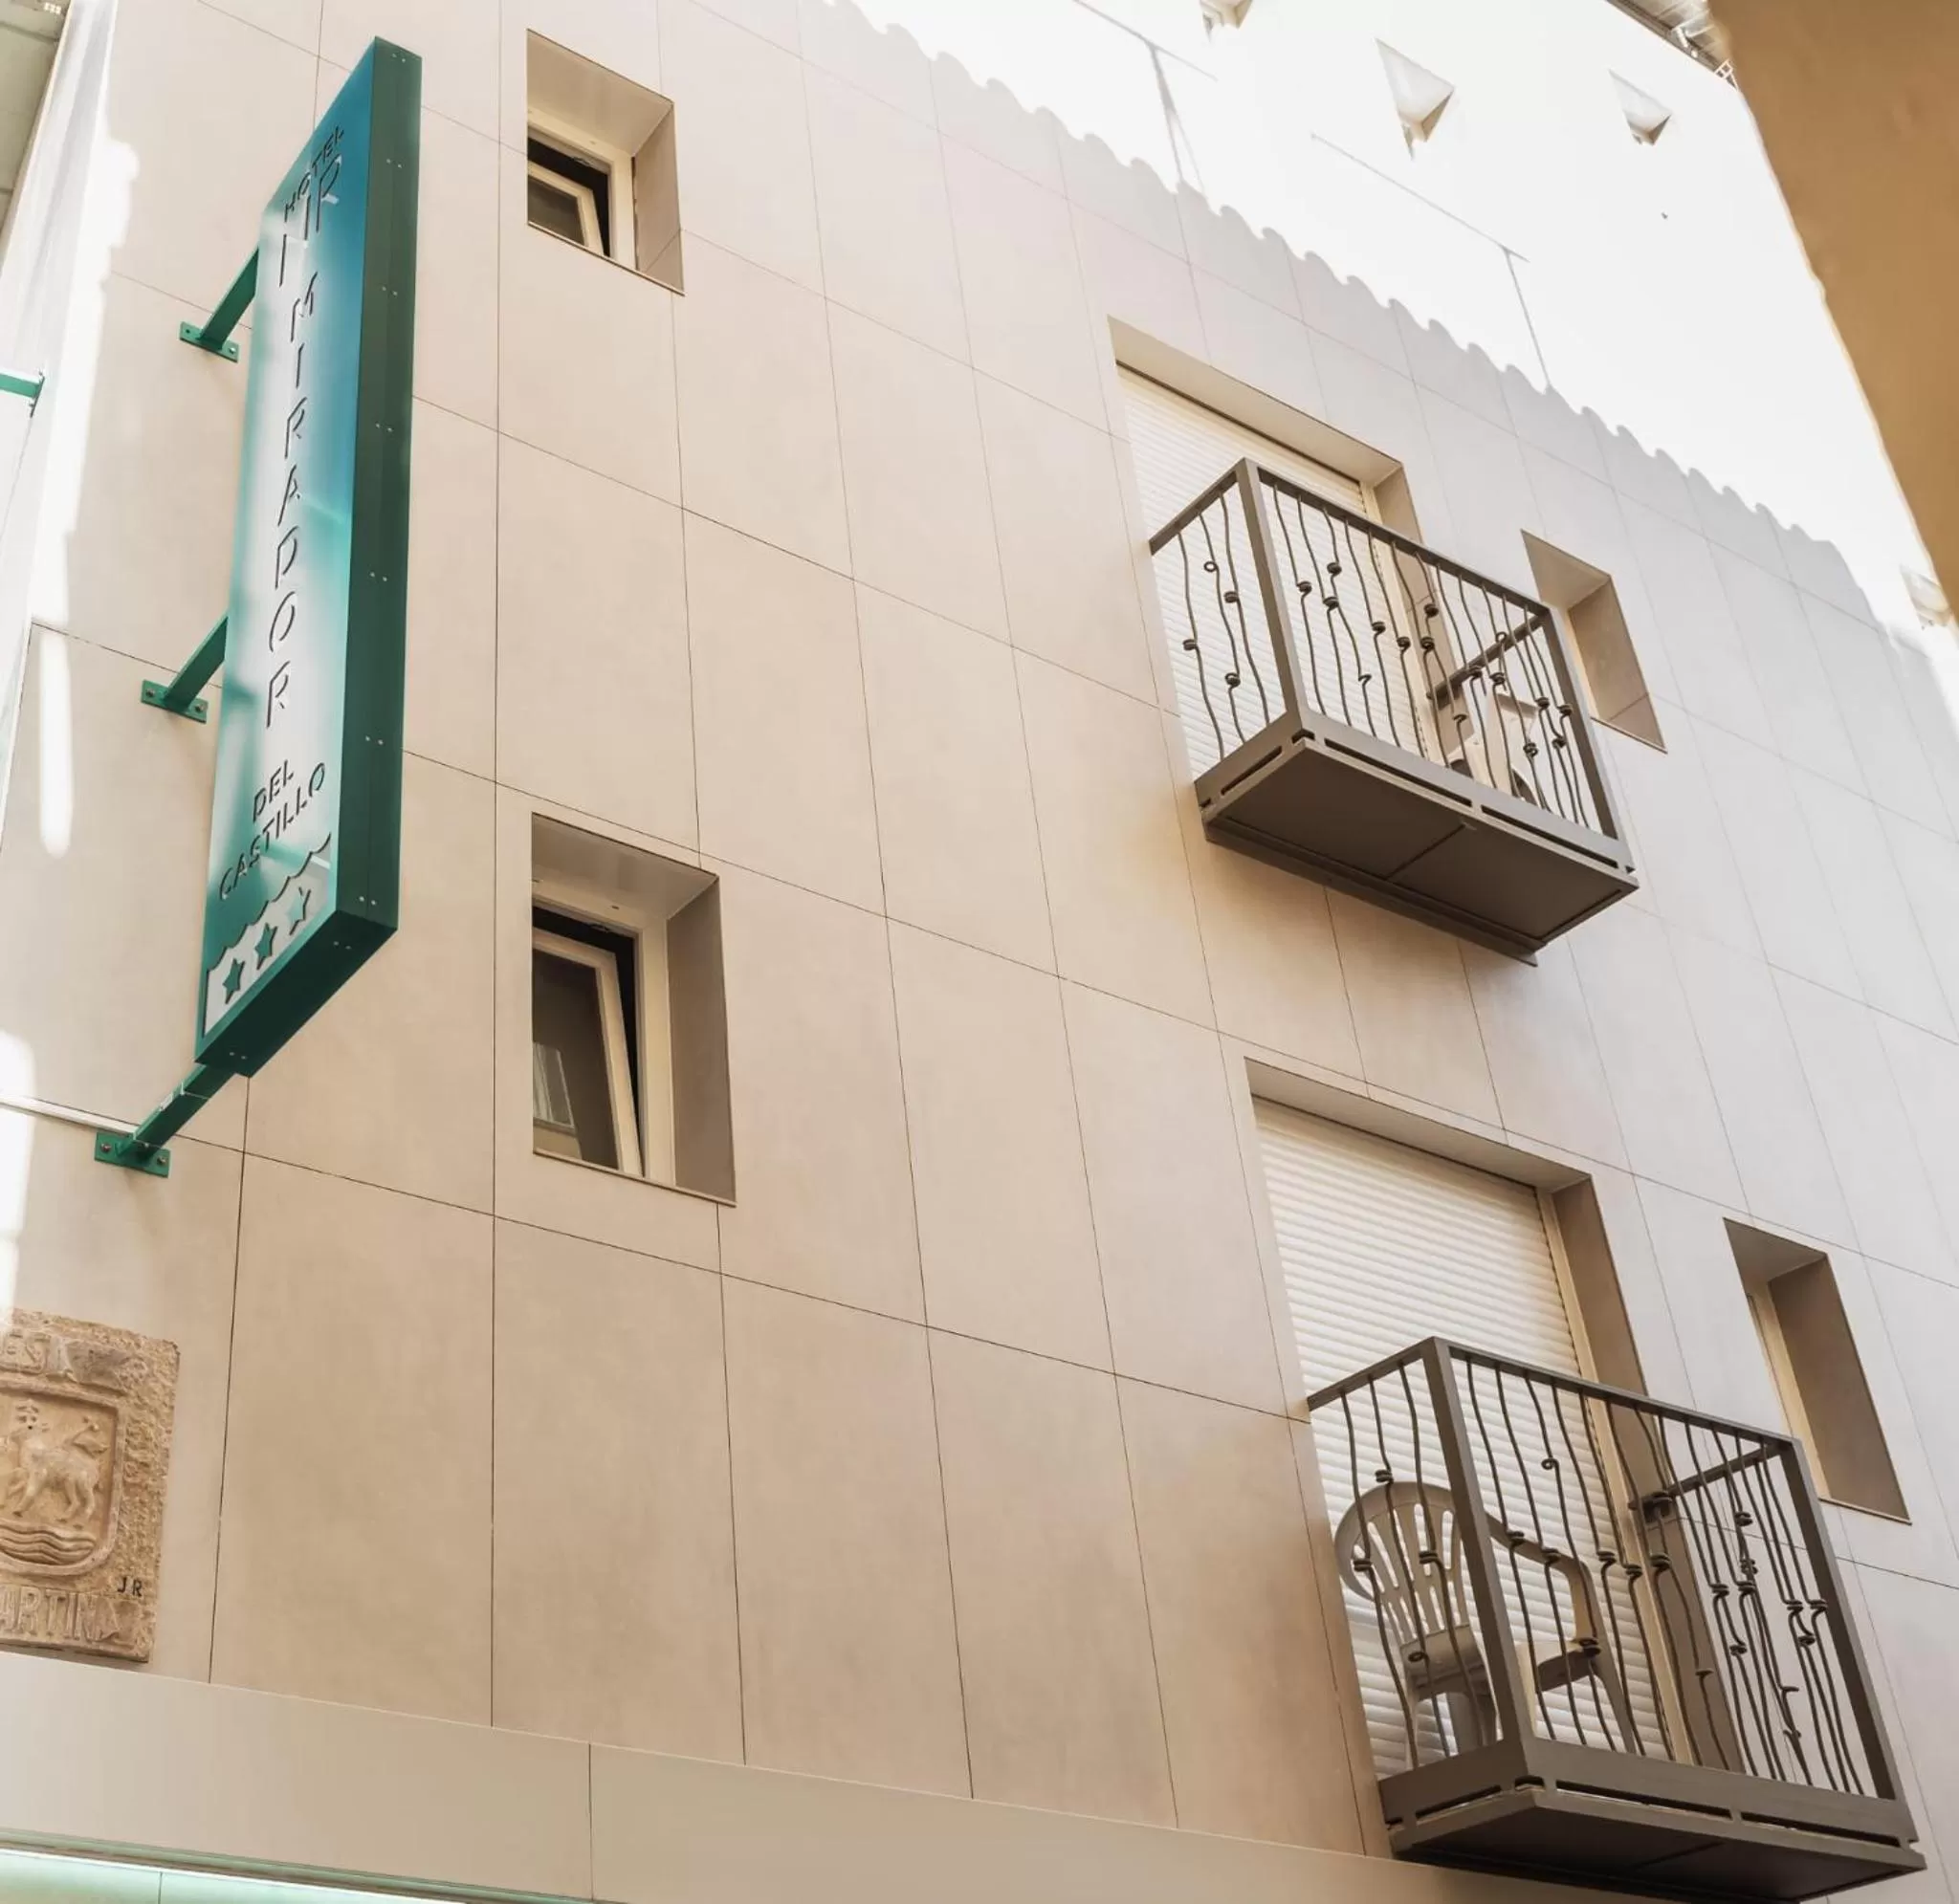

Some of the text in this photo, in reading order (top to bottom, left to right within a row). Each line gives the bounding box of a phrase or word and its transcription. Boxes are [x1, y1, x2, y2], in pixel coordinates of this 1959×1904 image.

[284, 124, 344, 223] HOTEL
[265, 271, 319, 729] MIRADOR
[219, 762, 326, 903] CASTILLO
[253, 760, 295, 823] DEL
